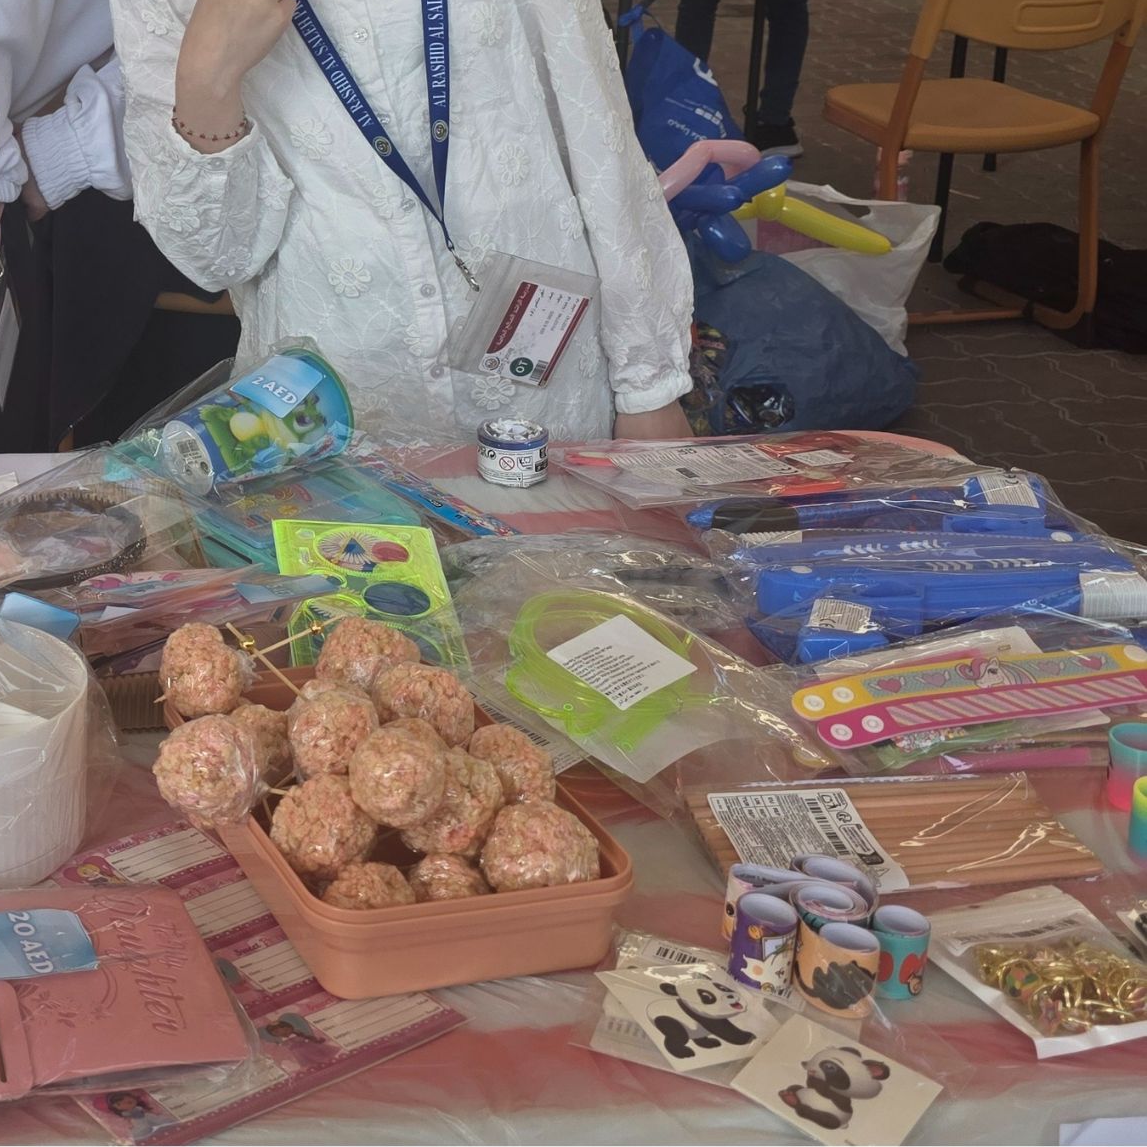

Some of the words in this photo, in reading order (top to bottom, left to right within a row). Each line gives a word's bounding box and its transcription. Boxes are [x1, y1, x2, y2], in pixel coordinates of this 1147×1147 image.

[296, 13, 329, 58] SALEH
[428, 24, 446, 40] AL
[321, 57, 339, 71] AL
[430, 42, 446, 89] RASHID
[330, 70, 365, 114] RASHID
[433, 91, 446, 108] AL
[357, 112, 375, 128] AL
[516, 360, 528, 373] OT
[252, 376, 263, 385] 2
[263, 381, 298, 404] AED
[8, 911, 35, 937] 20
[20, 939, 53, 974] AED
